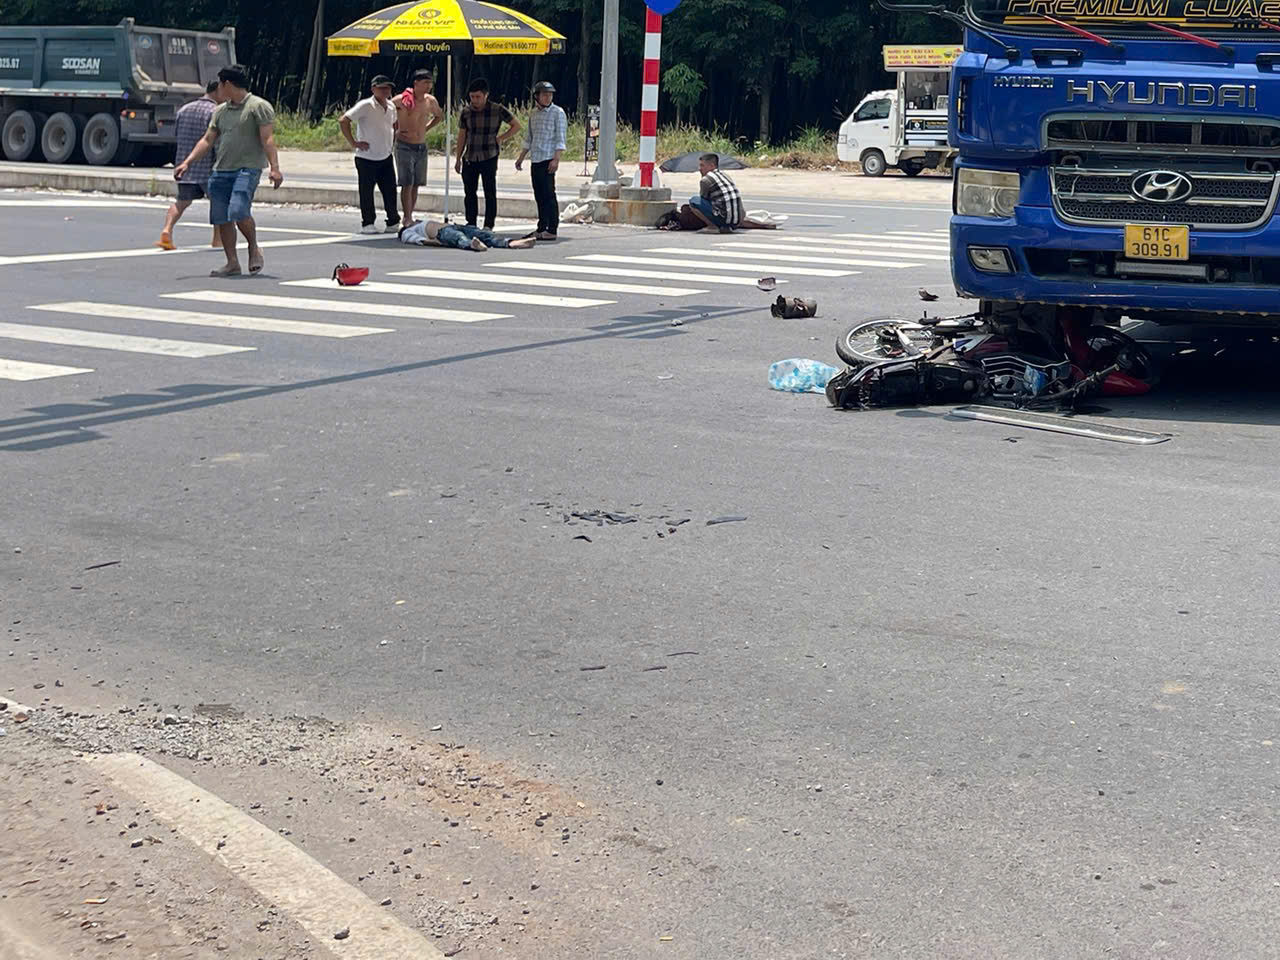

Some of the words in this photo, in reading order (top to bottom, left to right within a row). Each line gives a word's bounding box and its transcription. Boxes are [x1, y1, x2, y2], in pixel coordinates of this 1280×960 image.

[62, 57, 100, 70] SOOSAN
[994, 75, 1054, 89] HYUNDAI
[1067, 79, 1257, 108] HYUNDAI
[1143, 227, 1171, 242] 61C
[1131, 242, 1180, 258] 309.91
